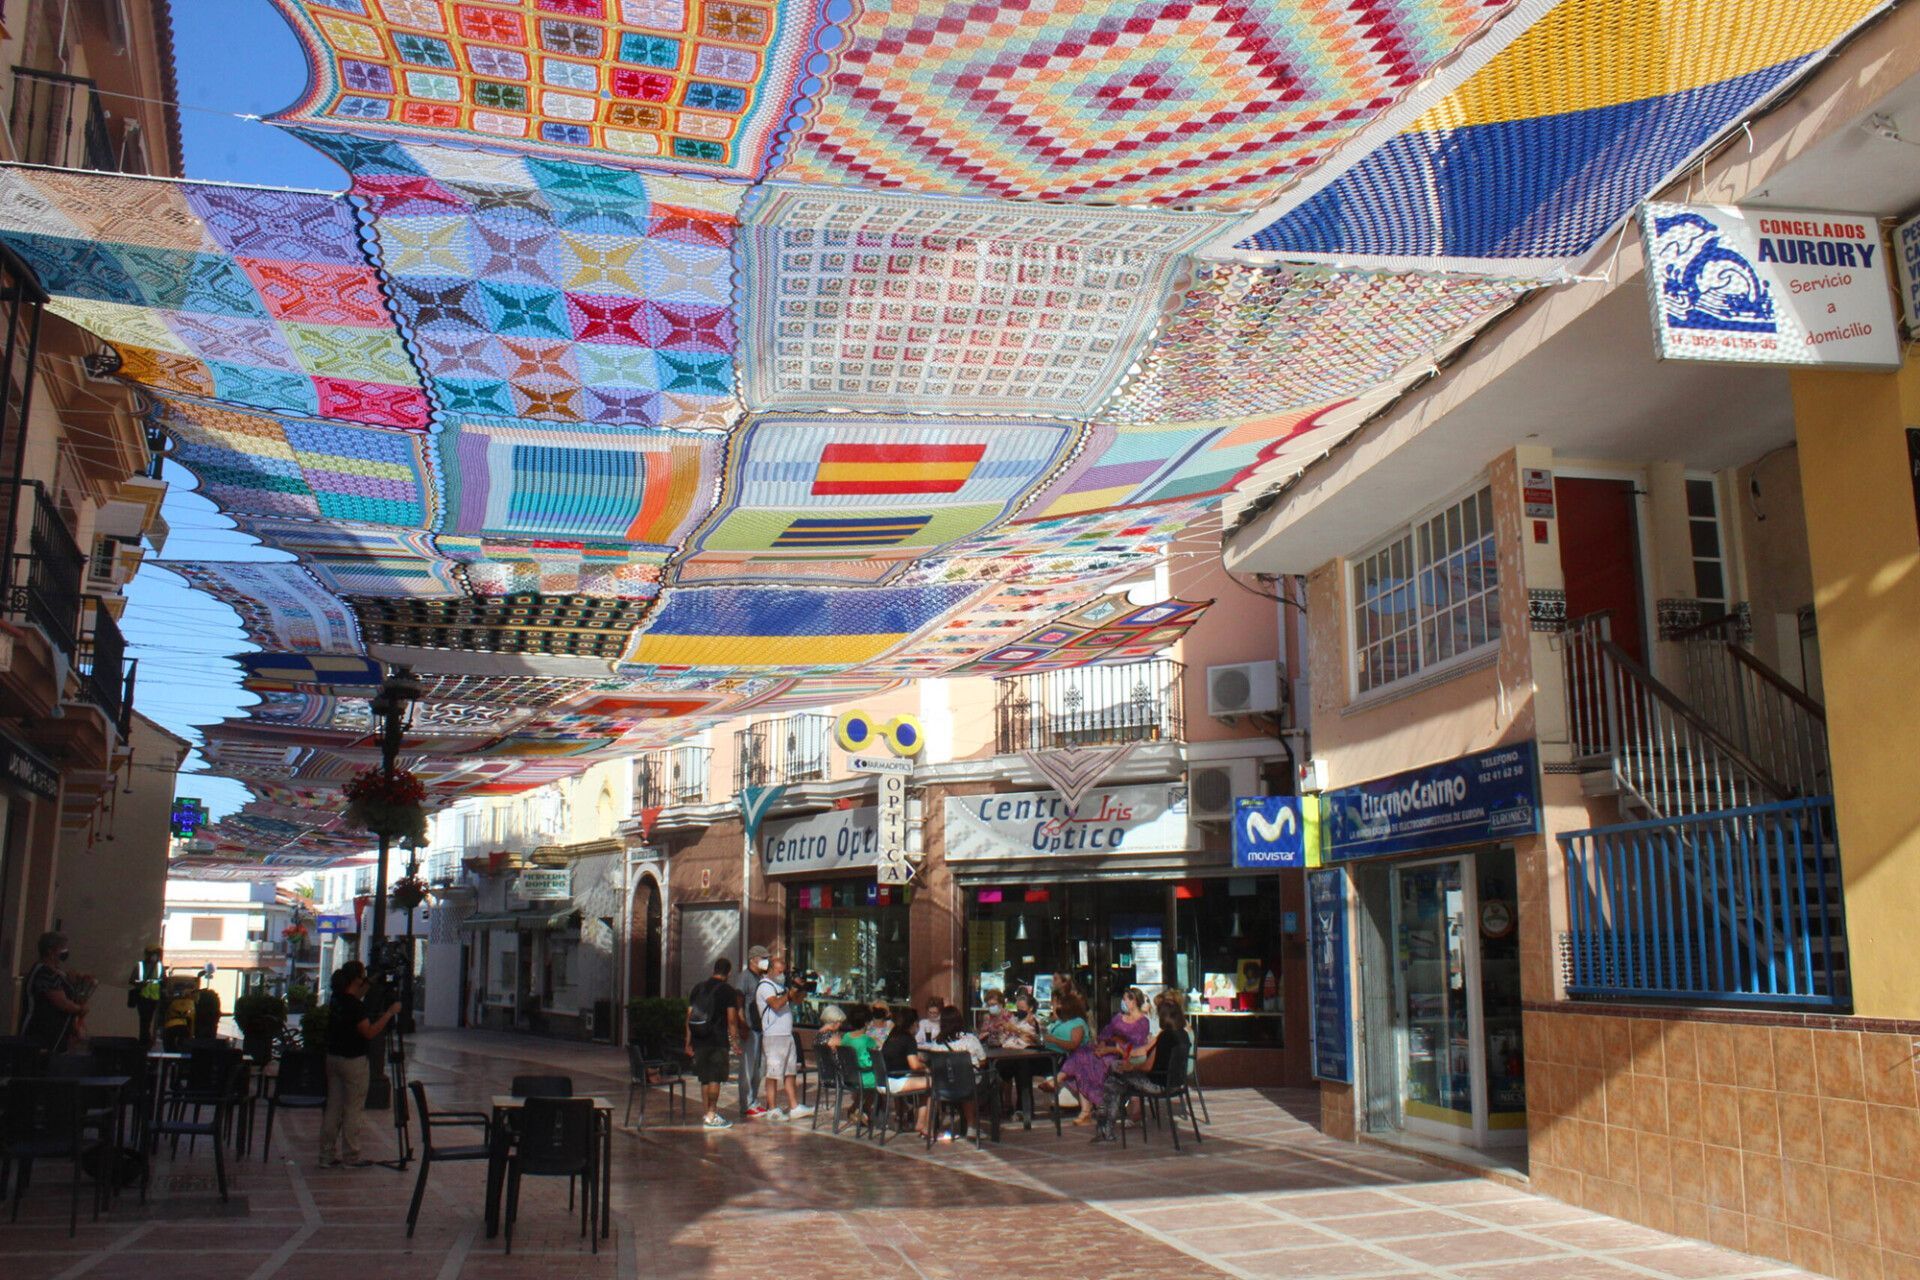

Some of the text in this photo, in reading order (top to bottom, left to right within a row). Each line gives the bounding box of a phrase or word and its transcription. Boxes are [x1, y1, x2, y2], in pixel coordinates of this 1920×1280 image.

[1759, 219, 1866, 239] CONGELADOS
[1758, 238, 1875, 268] AURORY
[1790, 272, 1852, 294] Servicio
[1827, 302, 1836, 314] a
[1721, 336, 1737, 348] 41
[1760, 339, 1777, 350] 35
[1805, 322, 1872, 345] domicilio
[1480, 751, 1518, 768] TELEFONO
[1492, 770, 1501, 780] 41
[979, 795, 1132, 822] Centro Iris
[1491, 808, 1527, 826] EURONICS
[887, 777, 901, 880] OPTICA
[765, 817, 878, 863] Centro Ópti
[1247, 851, 1295, 861] movistar
